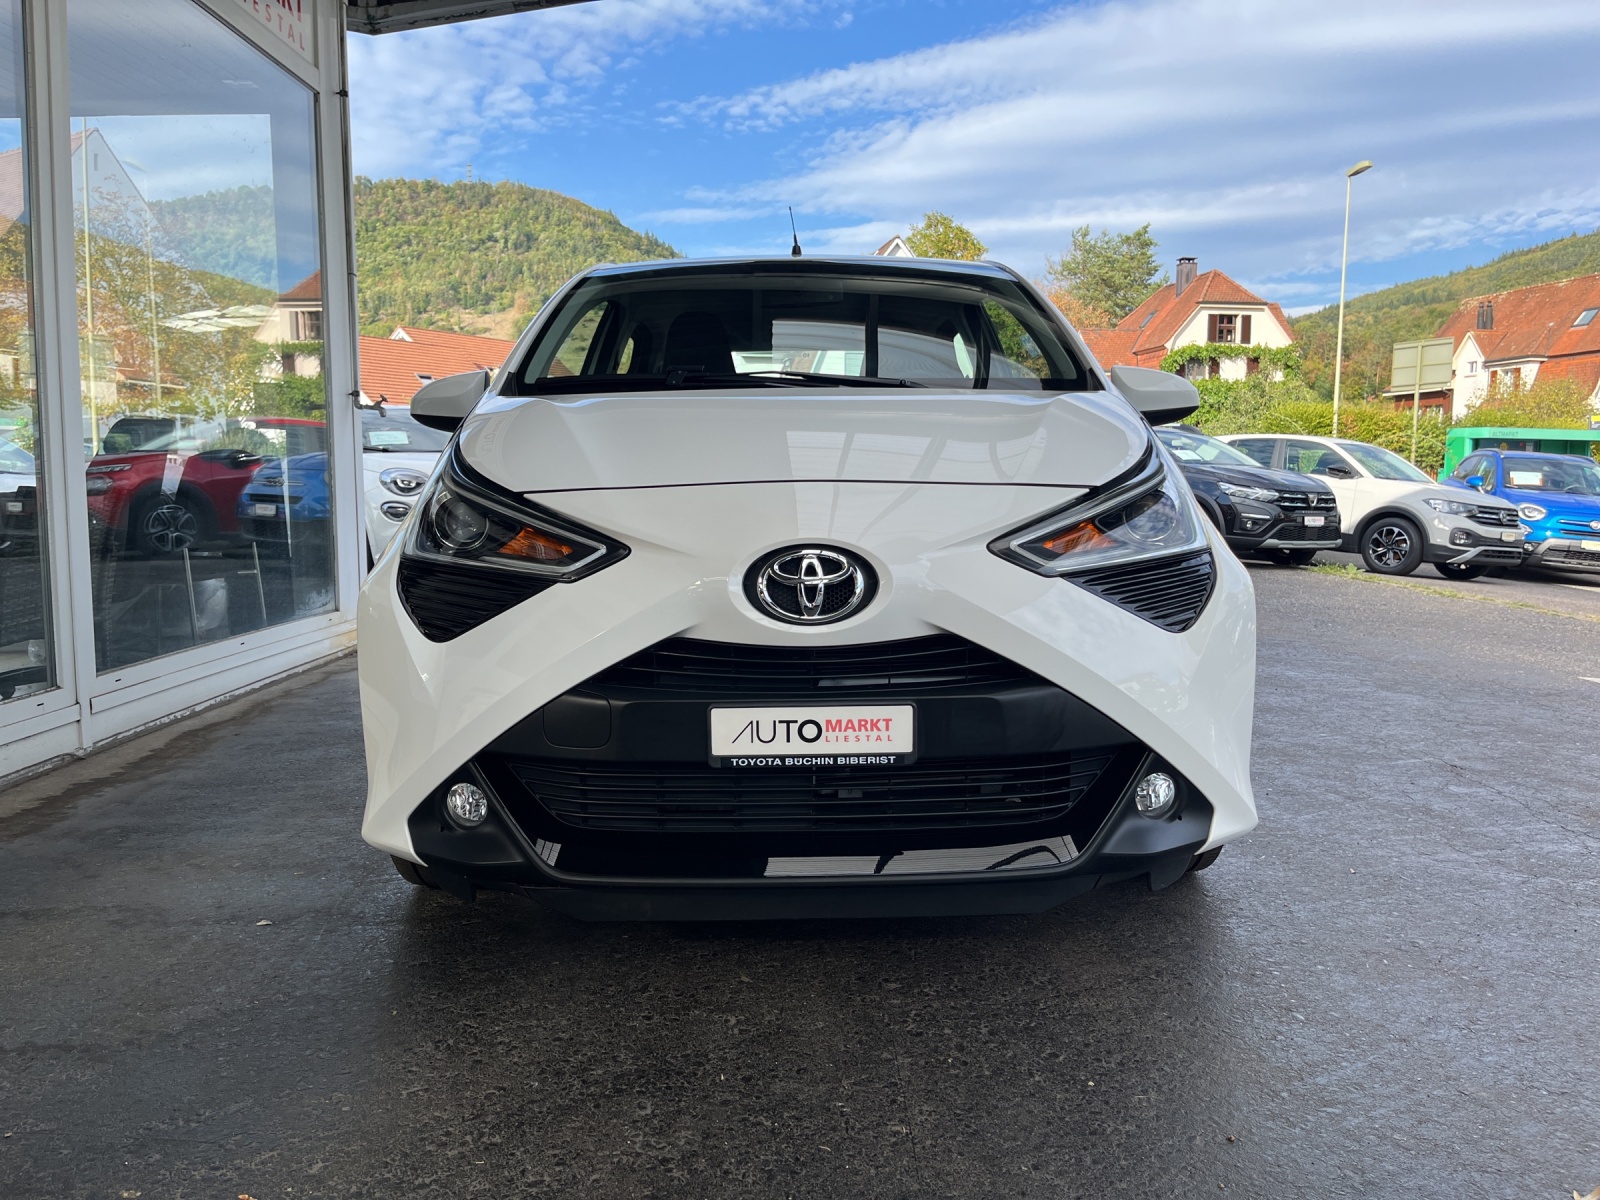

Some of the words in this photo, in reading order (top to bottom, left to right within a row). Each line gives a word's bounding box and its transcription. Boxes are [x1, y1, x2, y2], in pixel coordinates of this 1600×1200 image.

[244, 0, 305, 51] ESTAL
[825, 718, 893, 733] MARKT
[825, 735, 893, 743] LIESTAL
[730, 757, 782, 766] TOYOTA
[837, 756, 896, 765] BIBERIST
